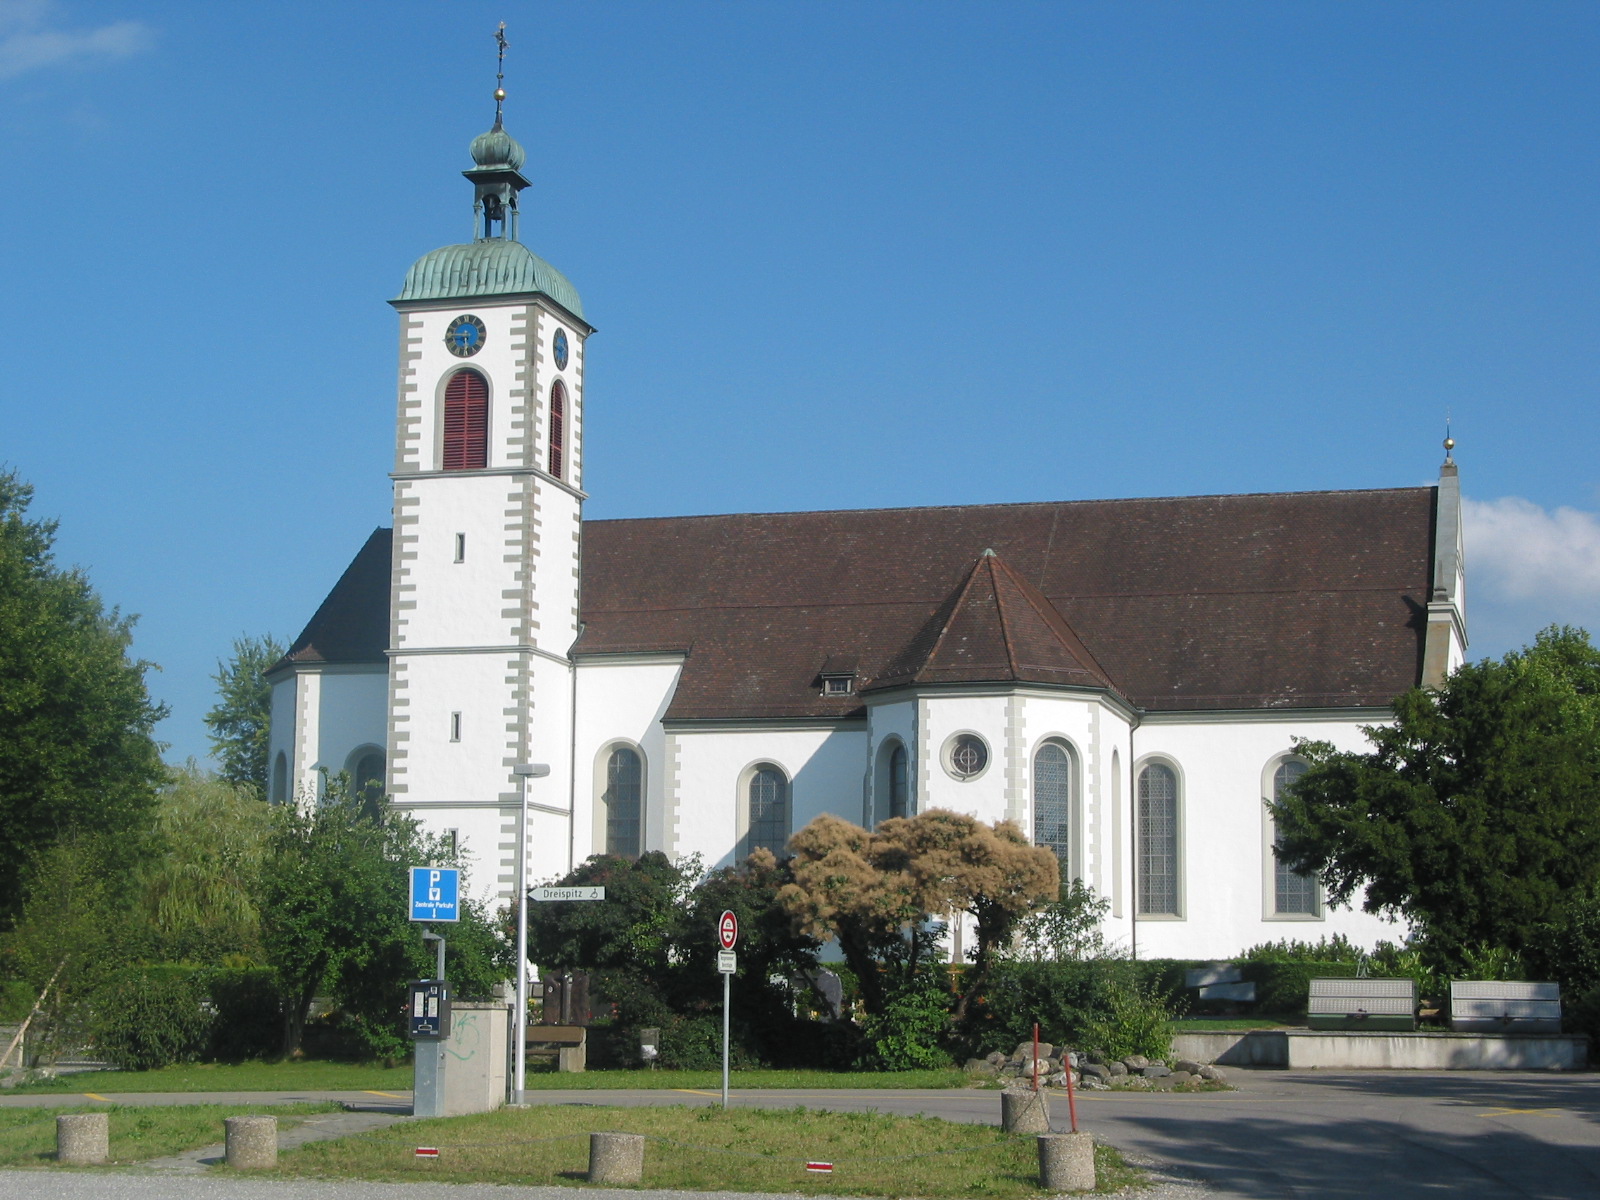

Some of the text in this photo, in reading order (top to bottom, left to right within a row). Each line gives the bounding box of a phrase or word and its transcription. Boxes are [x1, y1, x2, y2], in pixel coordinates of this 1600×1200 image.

[430, 870, 441, 888] P
[543, 888, 583, 899] Dreispitz
[435, 901, 454, 909] Parkuhr
